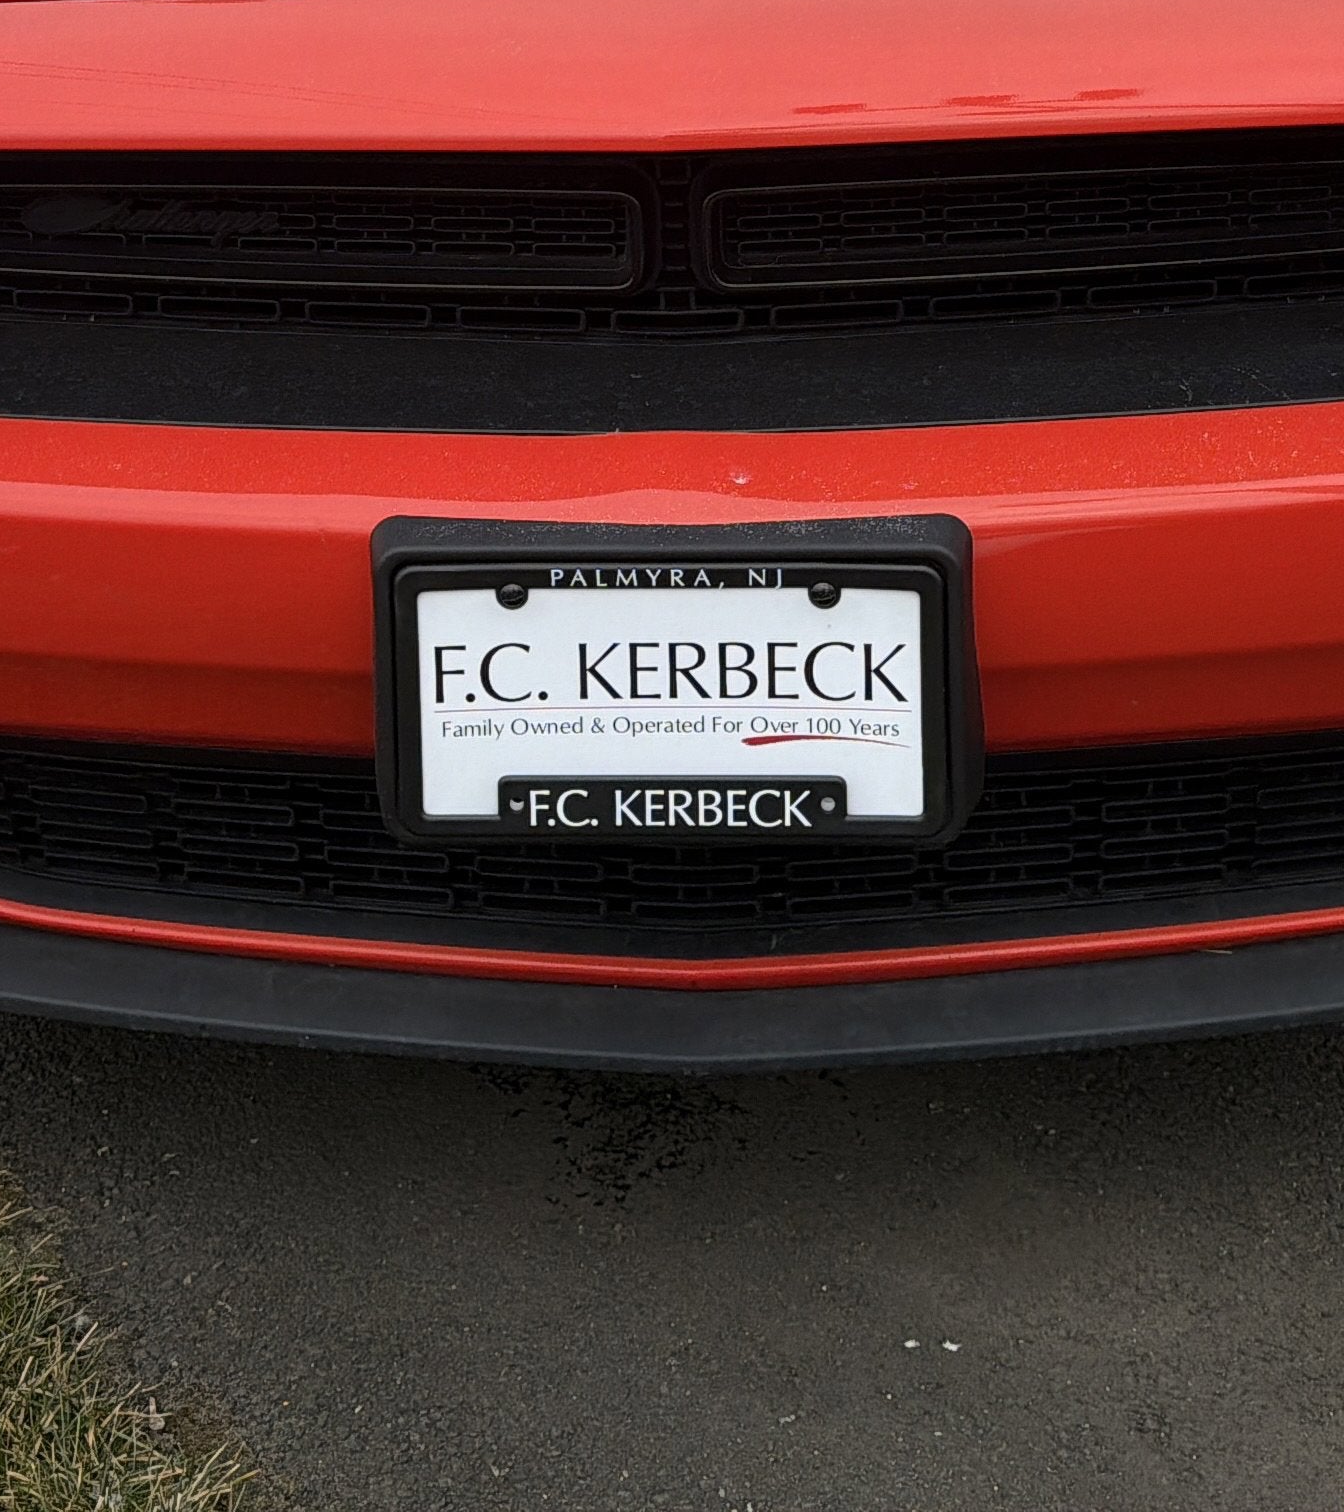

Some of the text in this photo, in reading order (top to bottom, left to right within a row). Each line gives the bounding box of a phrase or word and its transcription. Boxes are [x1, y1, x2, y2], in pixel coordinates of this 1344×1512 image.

[550, 568, 783, 589] PALMYRA, NJ
[433, 641, 909, 704] F.C. KERBECK
[442, 715, 900, 740] Family Owned & Operated For Over 100 Years
[528, 789, 812, 828] F.C. KERBECK
